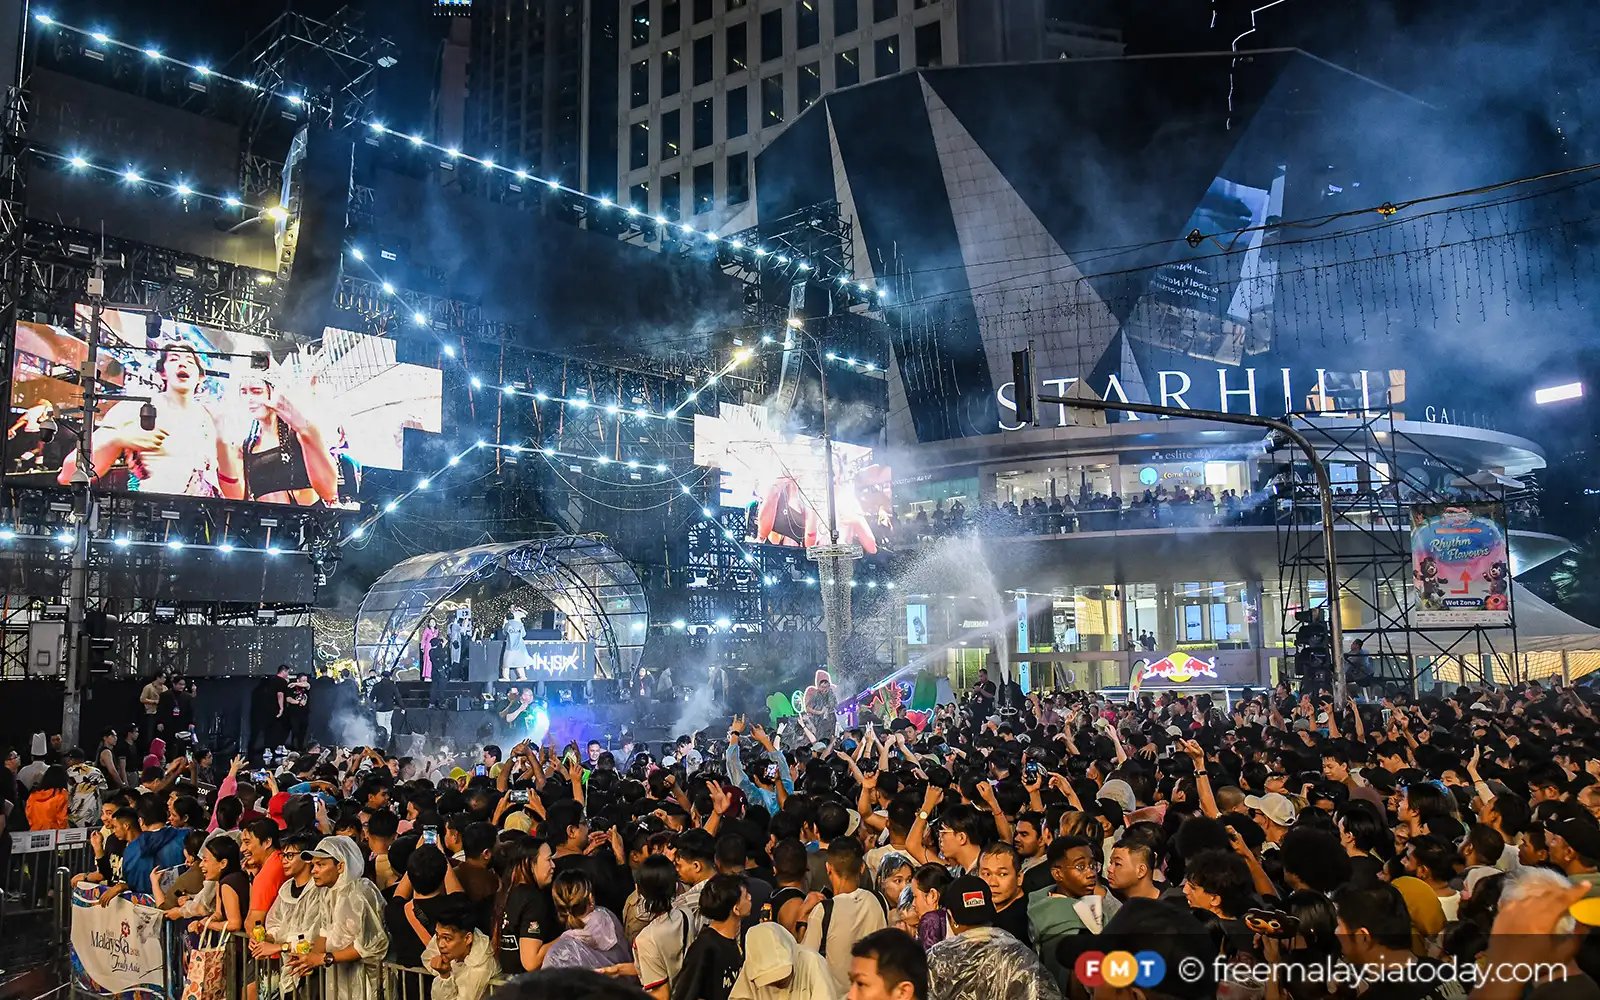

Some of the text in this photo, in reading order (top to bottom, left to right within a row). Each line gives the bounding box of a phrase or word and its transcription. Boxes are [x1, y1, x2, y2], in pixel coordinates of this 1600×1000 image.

[997, 367, 1390, 430] STARHILL
[1430, 537, 1471, 553] Rhythm
[1447, 547, 1491, 561] Flavours
[91, 931, 129, 954] Malaysia
